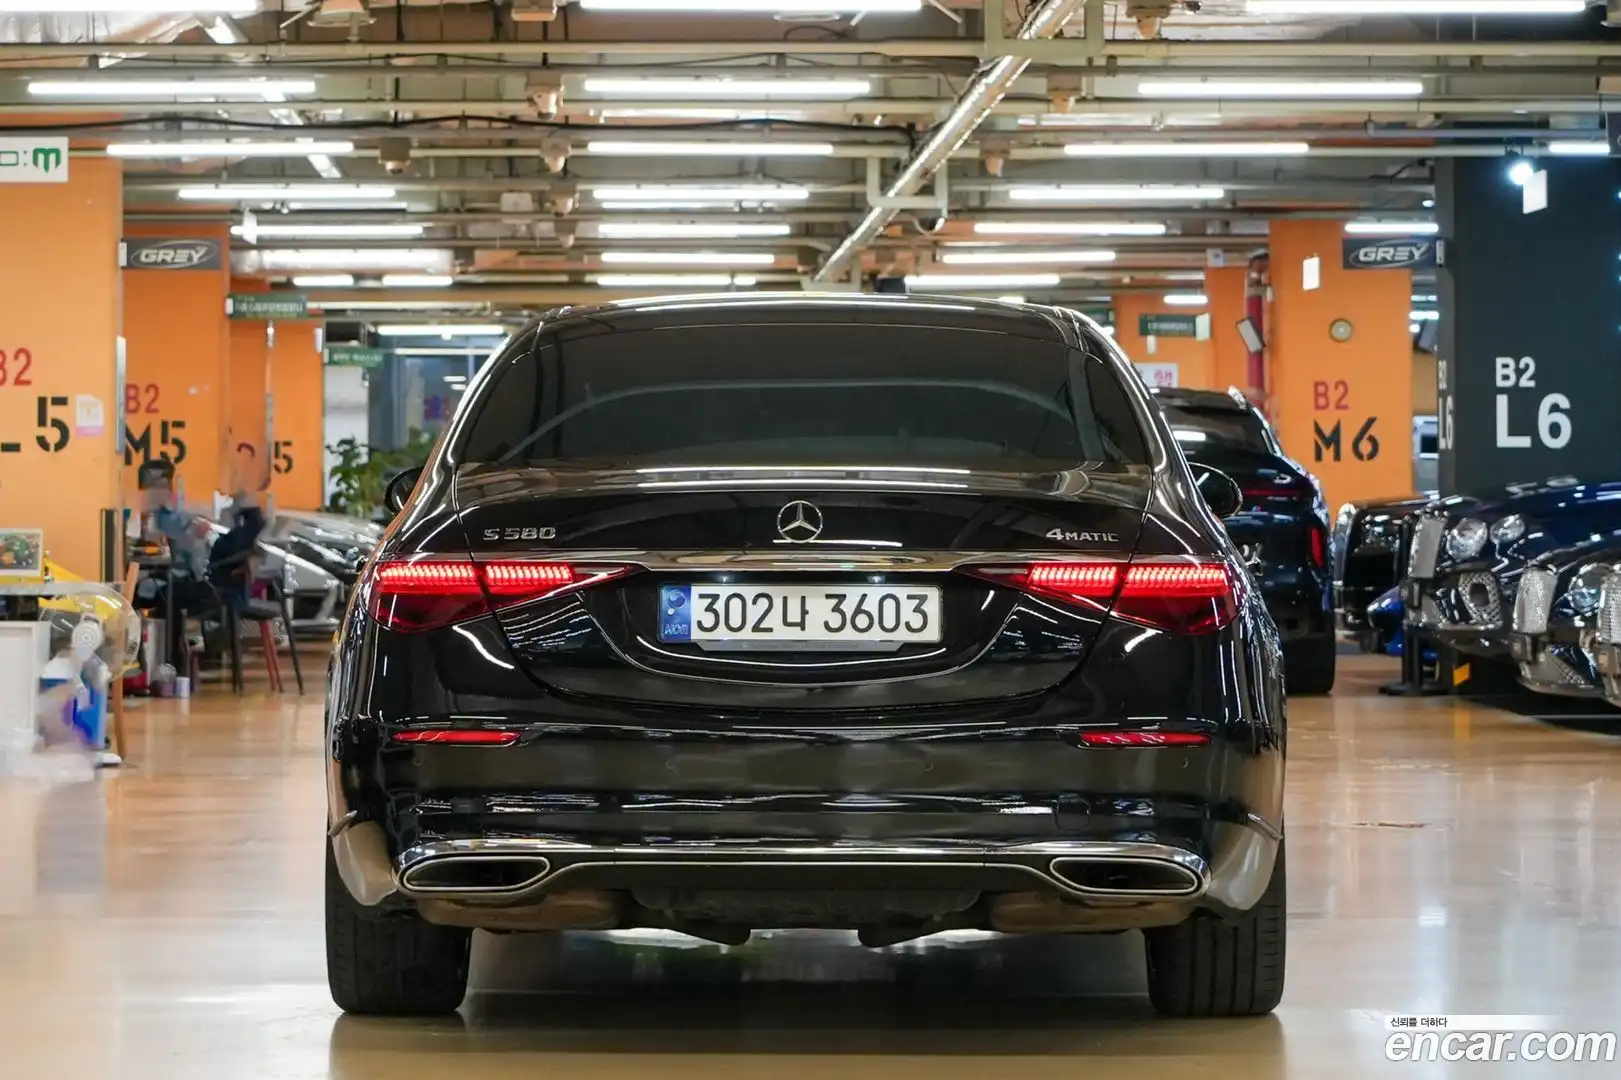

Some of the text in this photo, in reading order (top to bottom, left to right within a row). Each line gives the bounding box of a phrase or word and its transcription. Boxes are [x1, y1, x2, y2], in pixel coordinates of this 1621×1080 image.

[140, 246, 208, 264] GREY
[1358, 243, 1428, 262] GREY
[1496, 356, 1536, 387] B2
[126, 384, 159, 413] B2
[1314, 380, 1349, 411] B2
[1439, 396, 1453, 450] L6
[1496, 393, 1572, 449] L6
[125, 420, 187, 465] M5
[1314, 416, 1379, 462] M6
[483, 527, 556, 540] S 580
[1046, 528, 1119, 542] 4MATIC
[697, 593, 929, 633] 302나 3603
